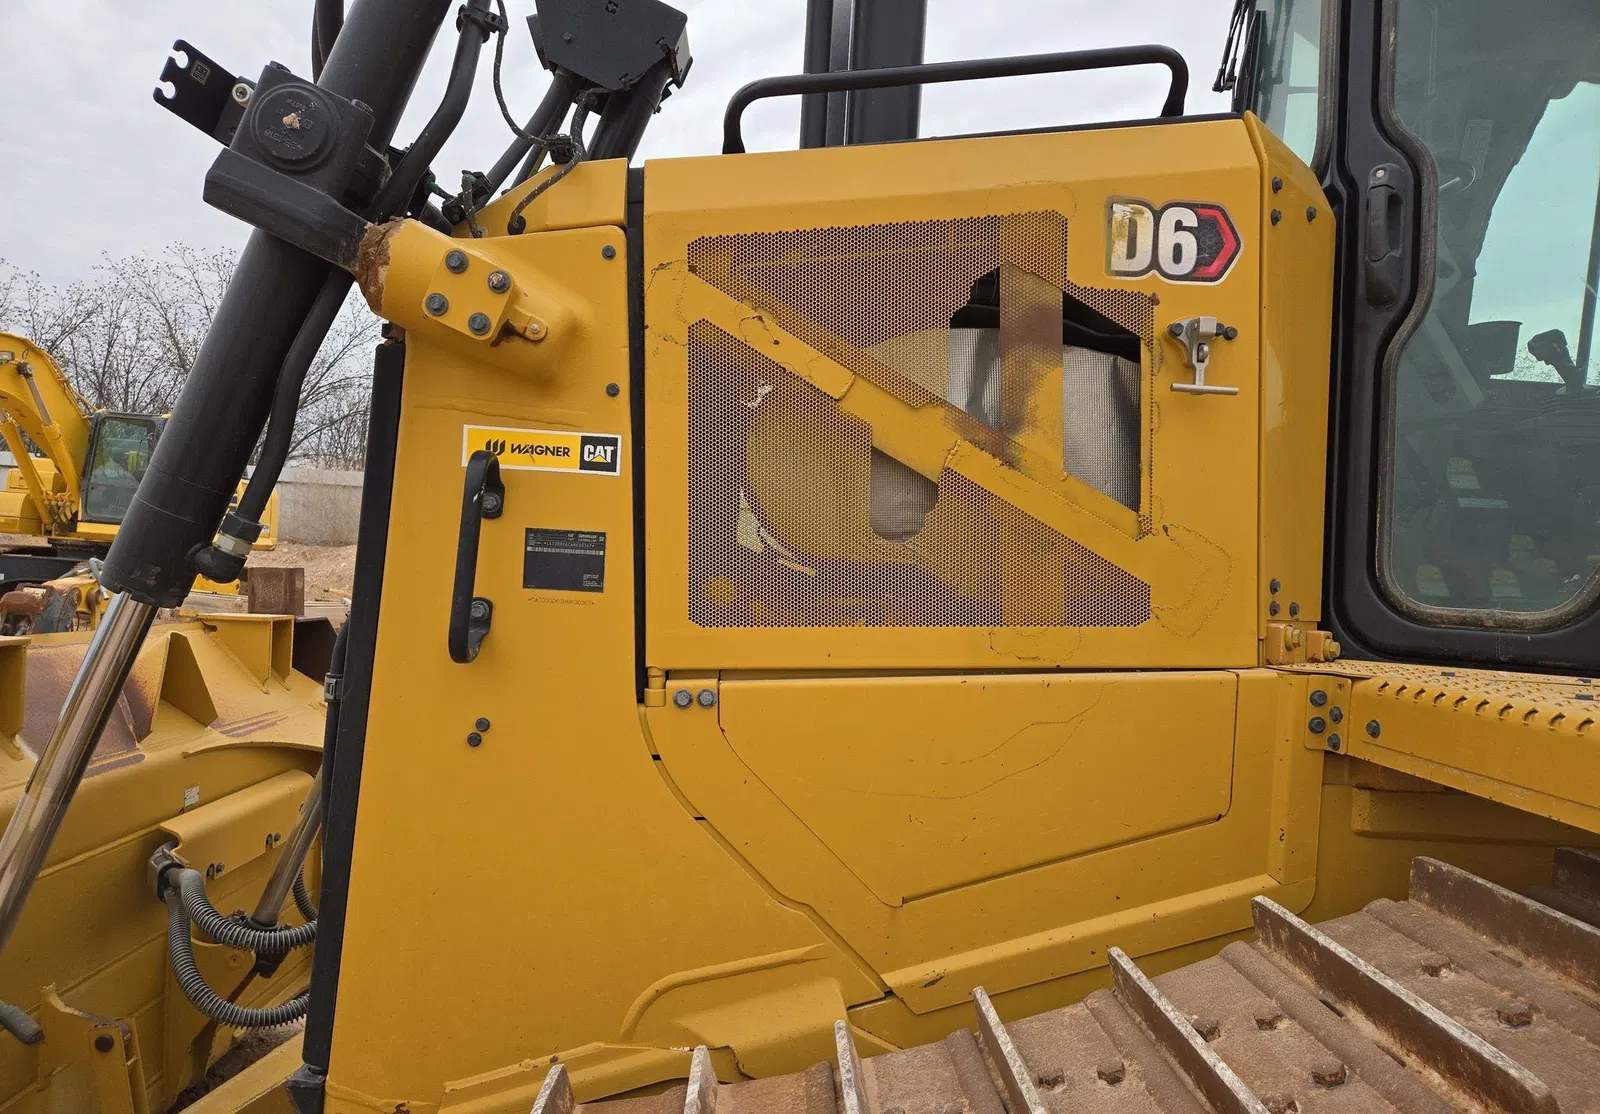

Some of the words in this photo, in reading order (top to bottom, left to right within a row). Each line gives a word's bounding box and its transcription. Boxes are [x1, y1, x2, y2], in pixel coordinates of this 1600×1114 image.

[1111, 203, 1198, 275] D6
[510, 443, 570, 458] WAGNER
[583, 444, 614, 462] CAT
